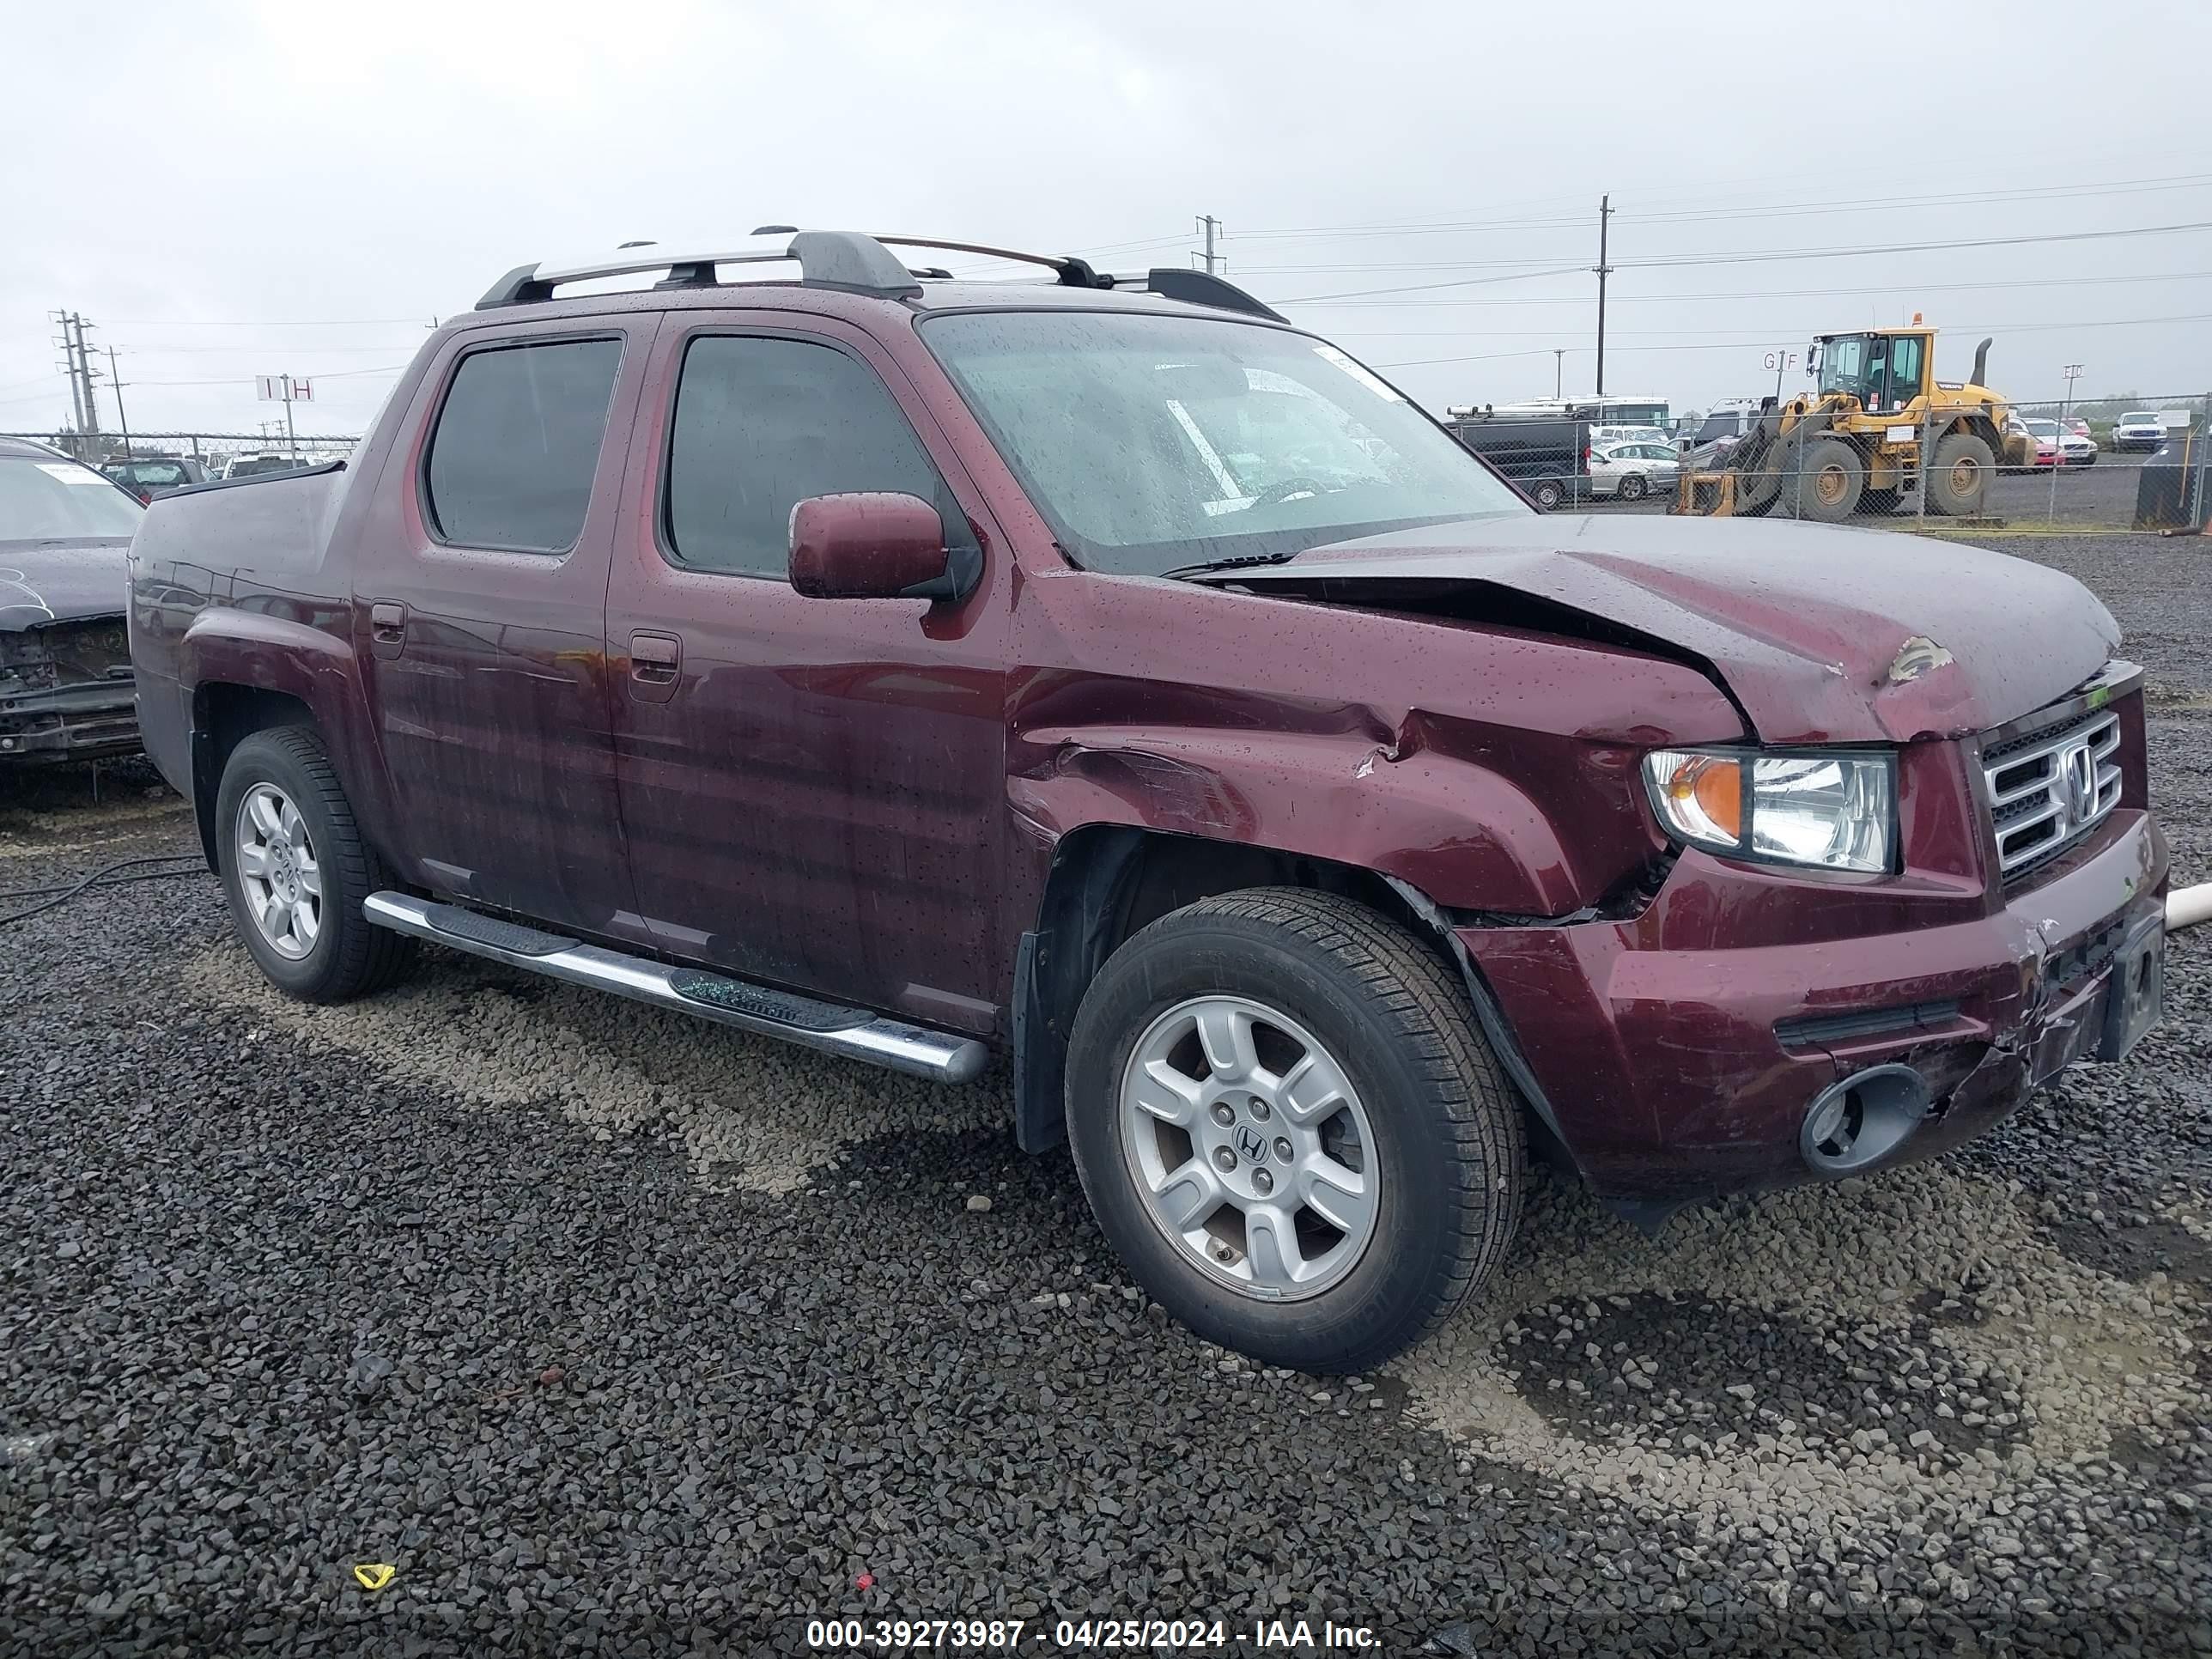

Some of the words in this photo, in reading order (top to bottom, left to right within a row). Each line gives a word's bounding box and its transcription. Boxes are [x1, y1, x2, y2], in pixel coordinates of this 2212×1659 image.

[1764, 352, 1775, 369] G
[1788, 354, 1798, 370] F
[293, 379, 310, 399] H
